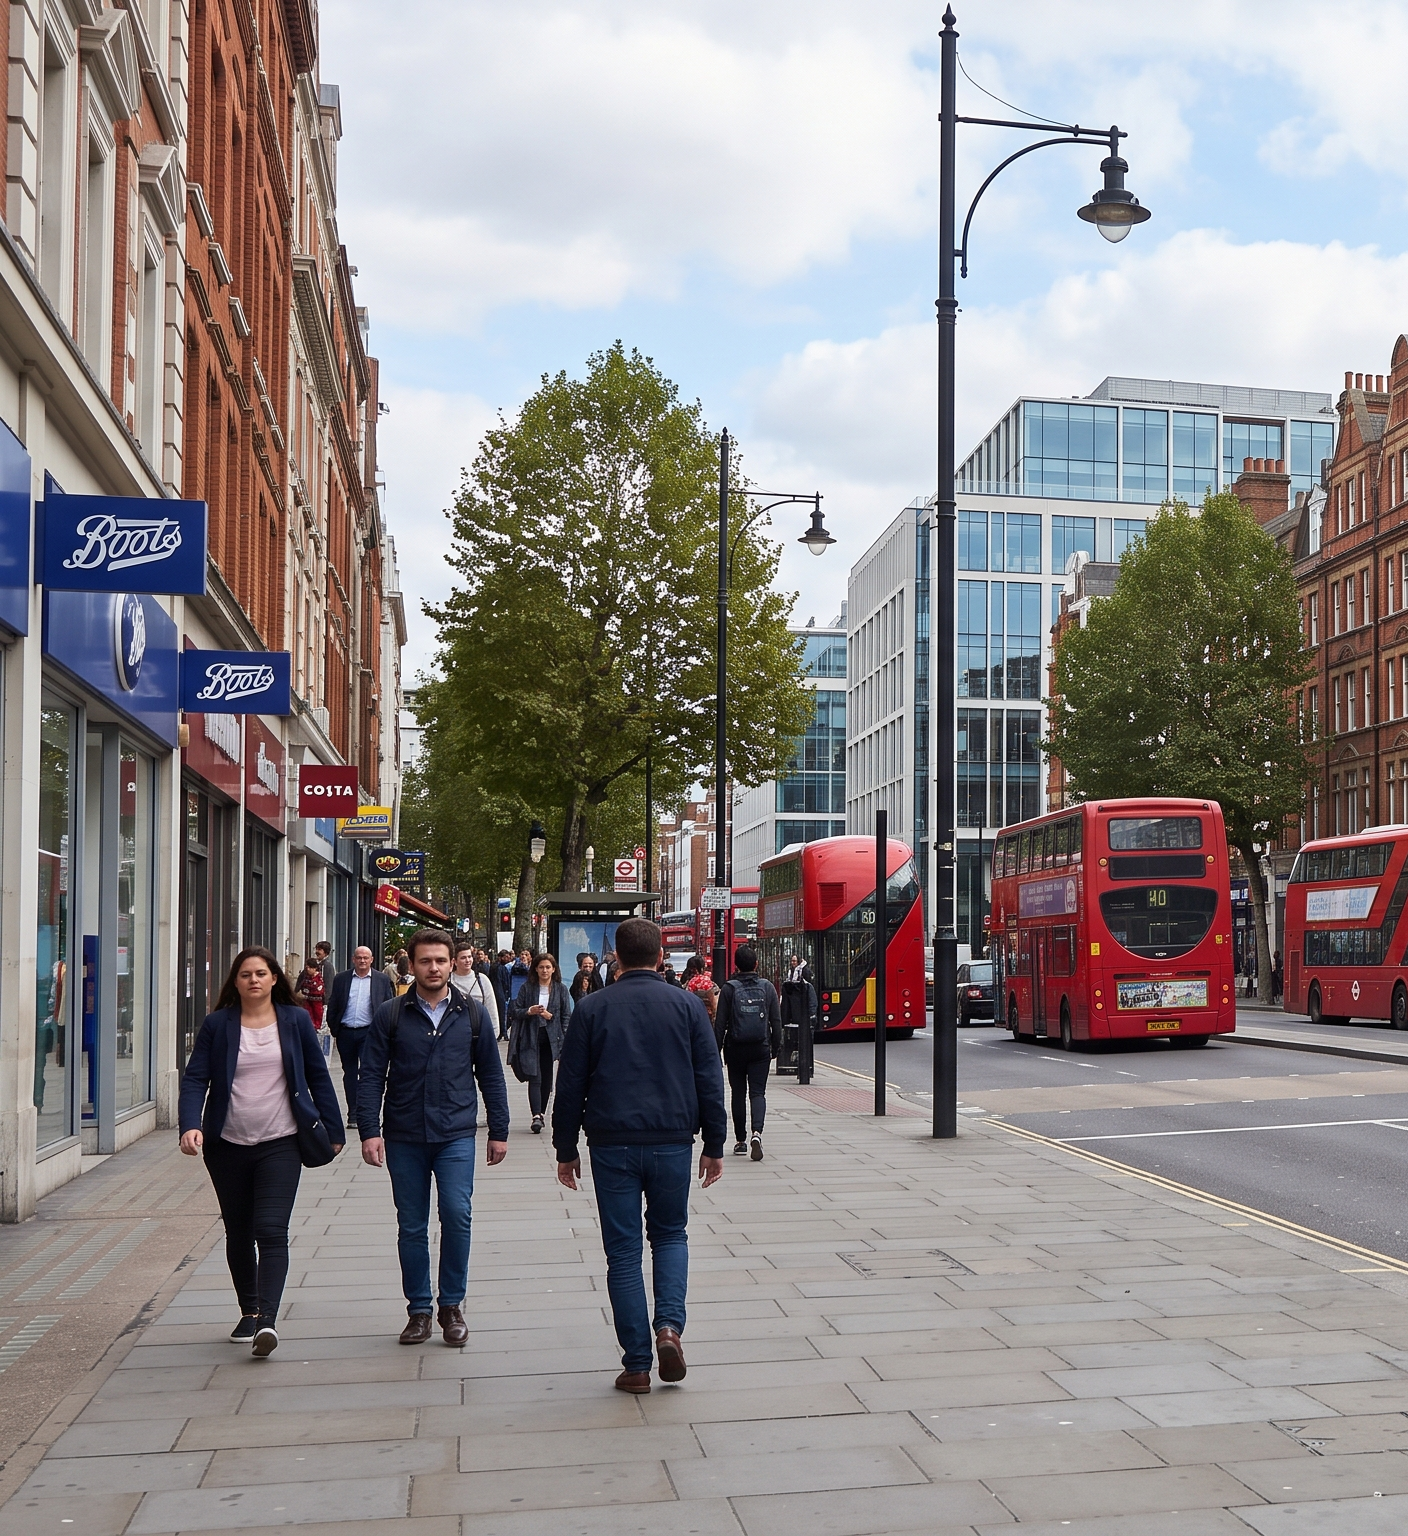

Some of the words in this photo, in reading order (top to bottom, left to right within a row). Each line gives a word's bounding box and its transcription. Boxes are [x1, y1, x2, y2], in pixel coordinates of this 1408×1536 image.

[62, 514, 182, 571] Boots
[196, 663, 275, 700] Boots
[303, 784, 354, 797] COSTA
